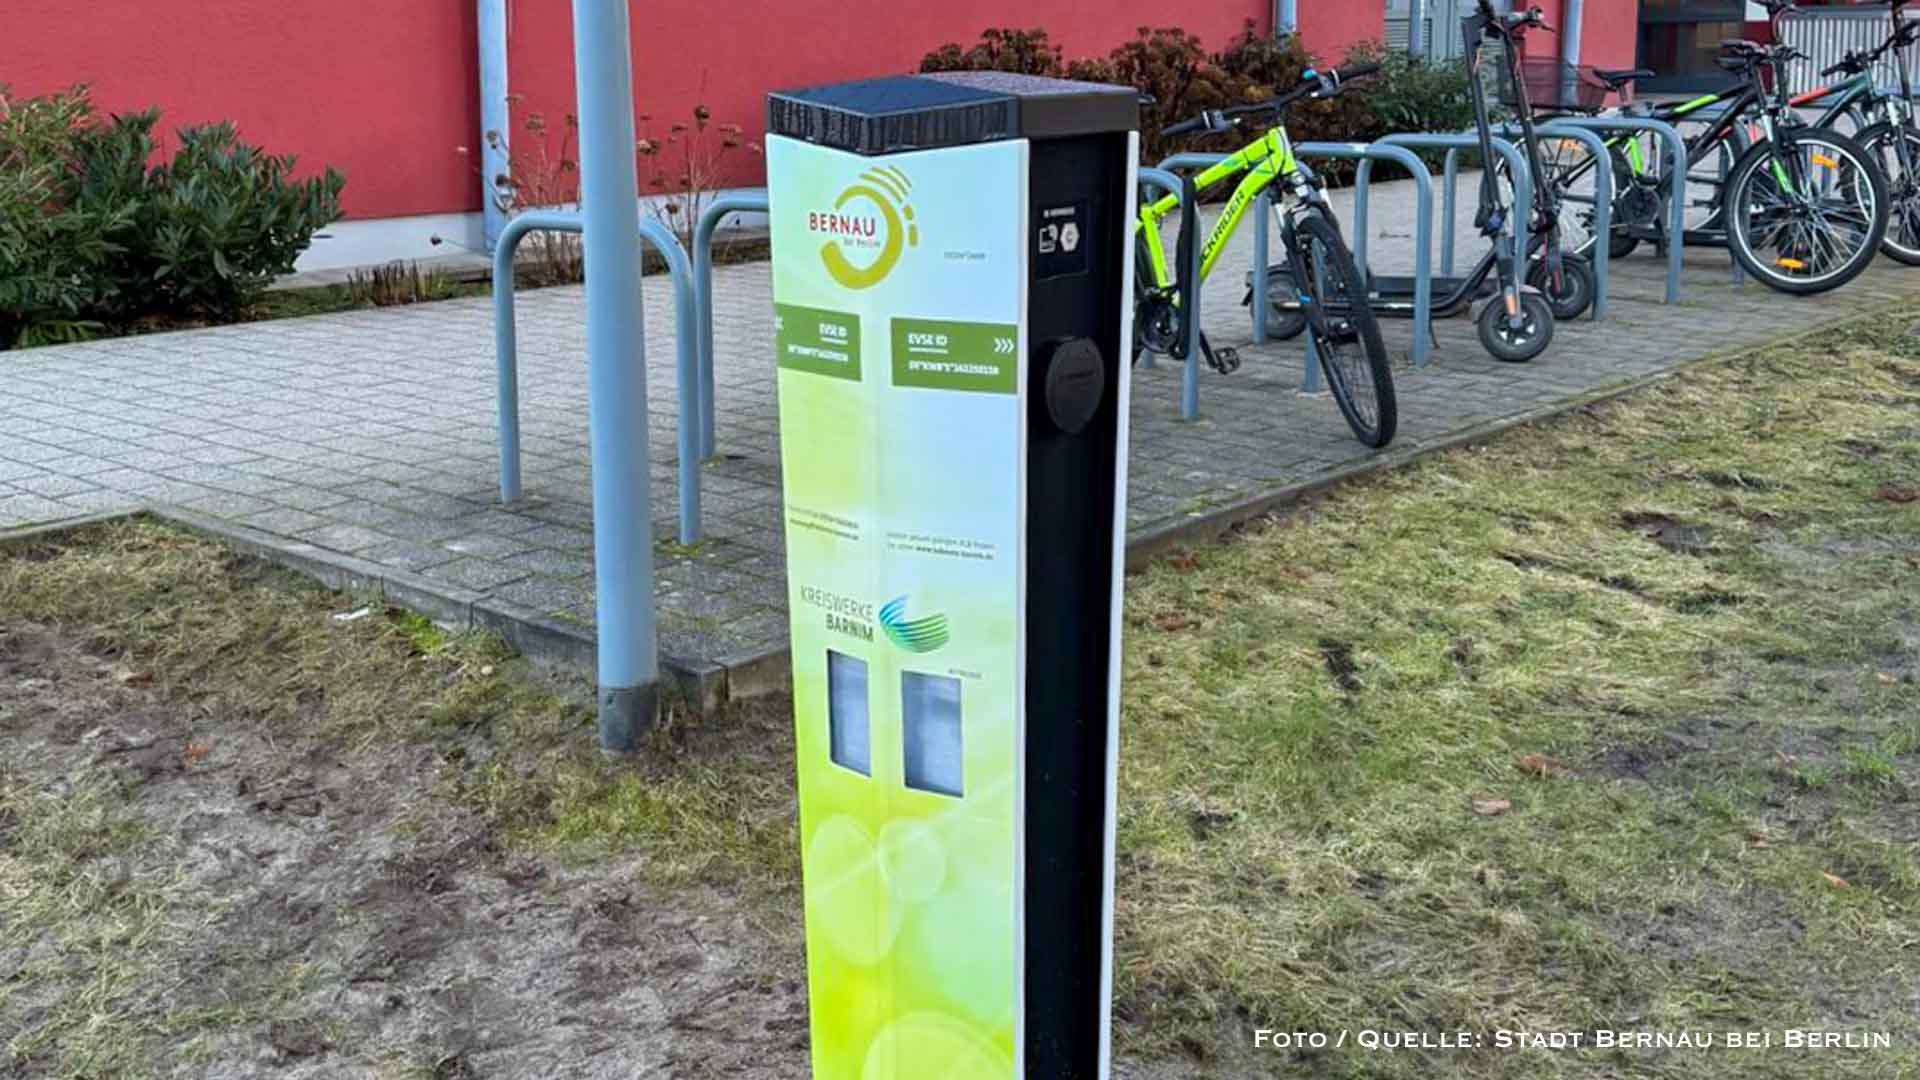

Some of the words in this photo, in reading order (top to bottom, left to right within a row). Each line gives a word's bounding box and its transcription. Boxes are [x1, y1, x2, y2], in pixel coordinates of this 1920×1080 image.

[809, 211, 876, 237] BERNAU
[907, 332, 934, 345] EVSE
[935, 334, 948, 347] ID
[800, 584, 873, 623] KREISWERKE
[825, 613, 875, 643] BARNIM
